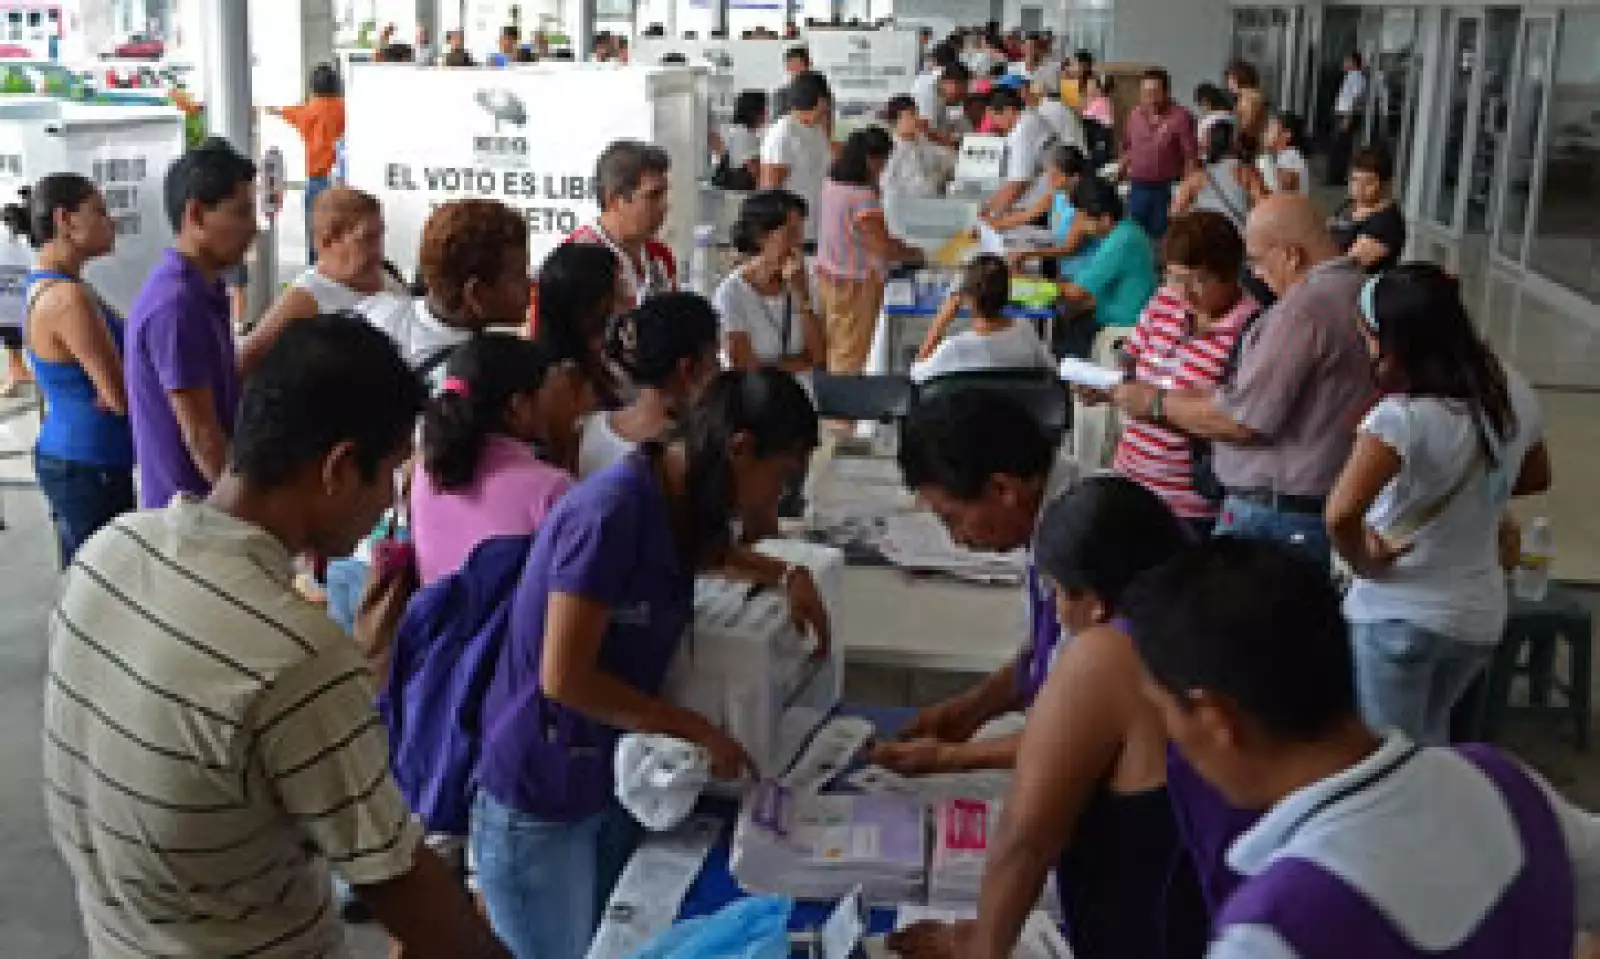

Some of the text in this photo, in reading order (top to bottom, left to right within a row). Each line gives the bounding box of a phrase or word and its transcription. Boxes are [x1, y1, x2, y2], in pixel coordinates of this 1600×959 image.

[386, 163, 419, 191] EL
[425, 166, 495, 192] VOTO
[503, 171, 536, 198] ES
